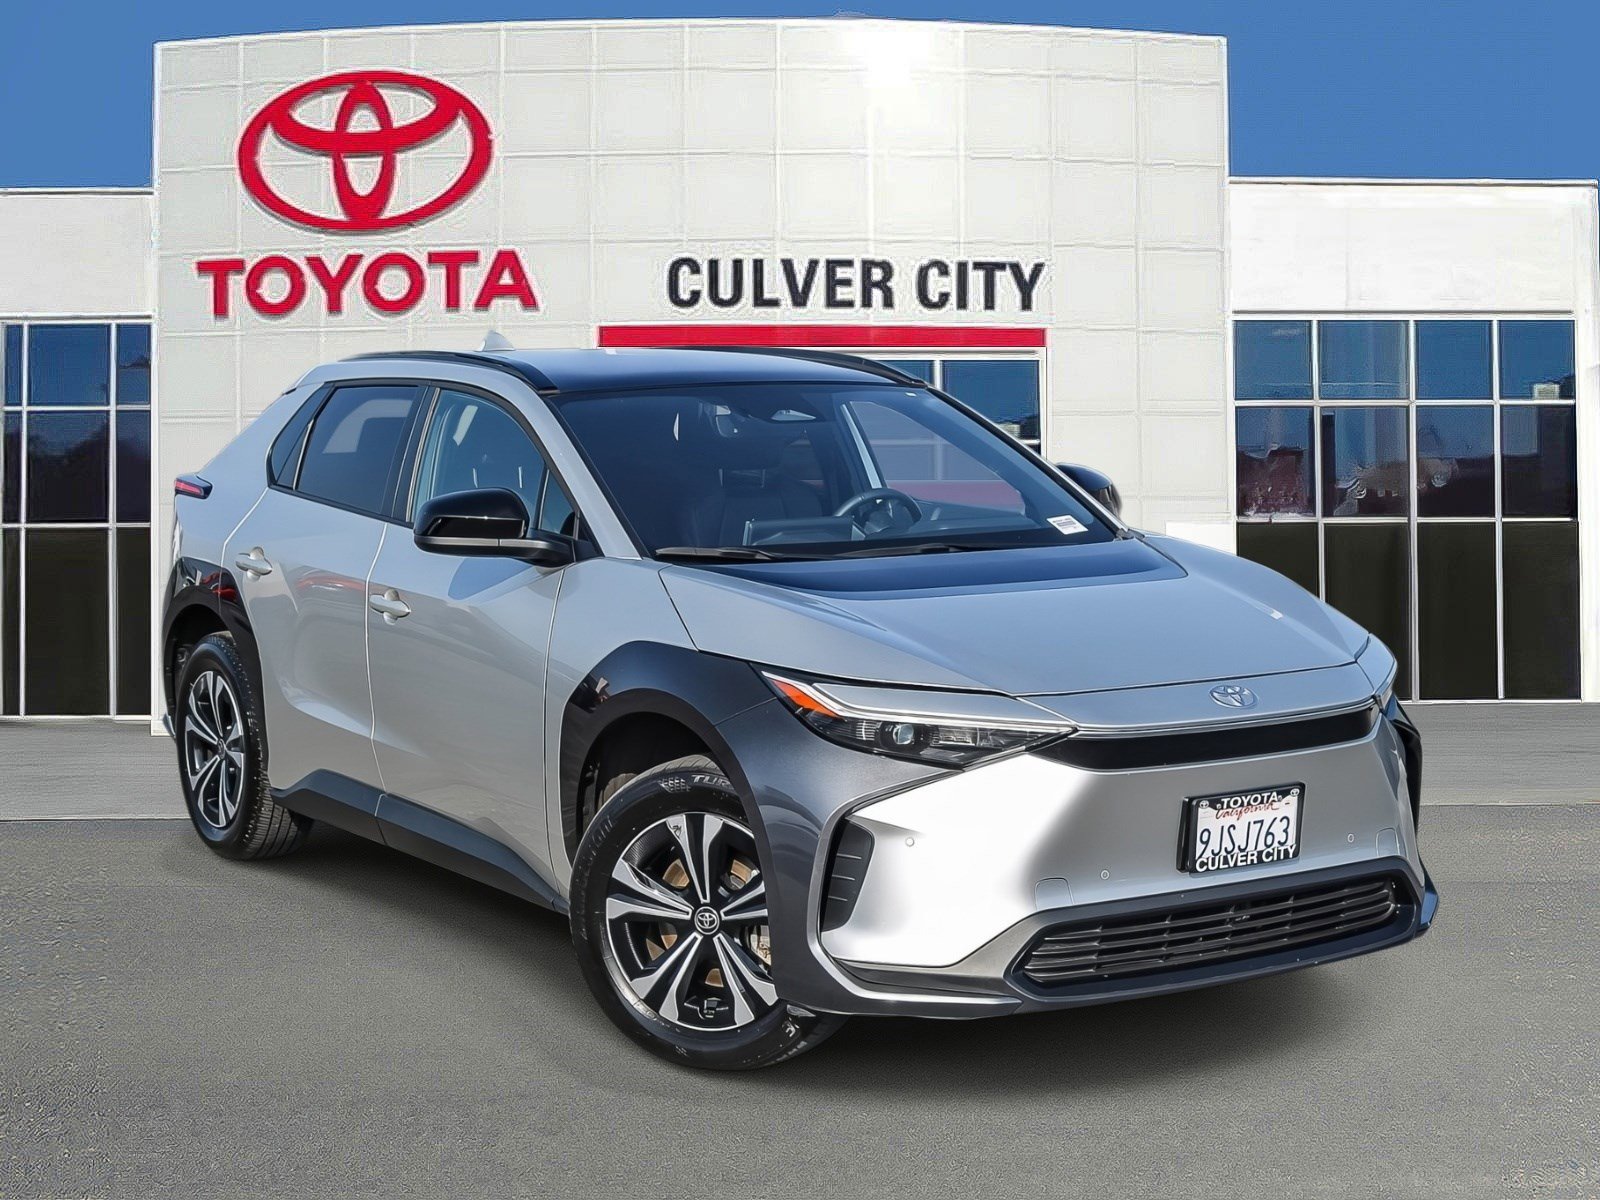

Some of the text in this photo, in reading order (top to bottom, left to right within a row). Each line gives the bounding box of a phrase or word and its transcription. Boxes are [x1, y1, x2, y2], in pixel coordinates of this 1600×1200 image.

[196, 249, 540, 318] TOYOTA
[667, 257, 1046, 312] CULVER CITY
[1215, 801, 1280, 821] California
[1220, 791, 1279, 809] TOYOTA
[1196, 815, 1290, 860] 9JSJ763
[1195, 844, 1297, 873] CULVER CITY
